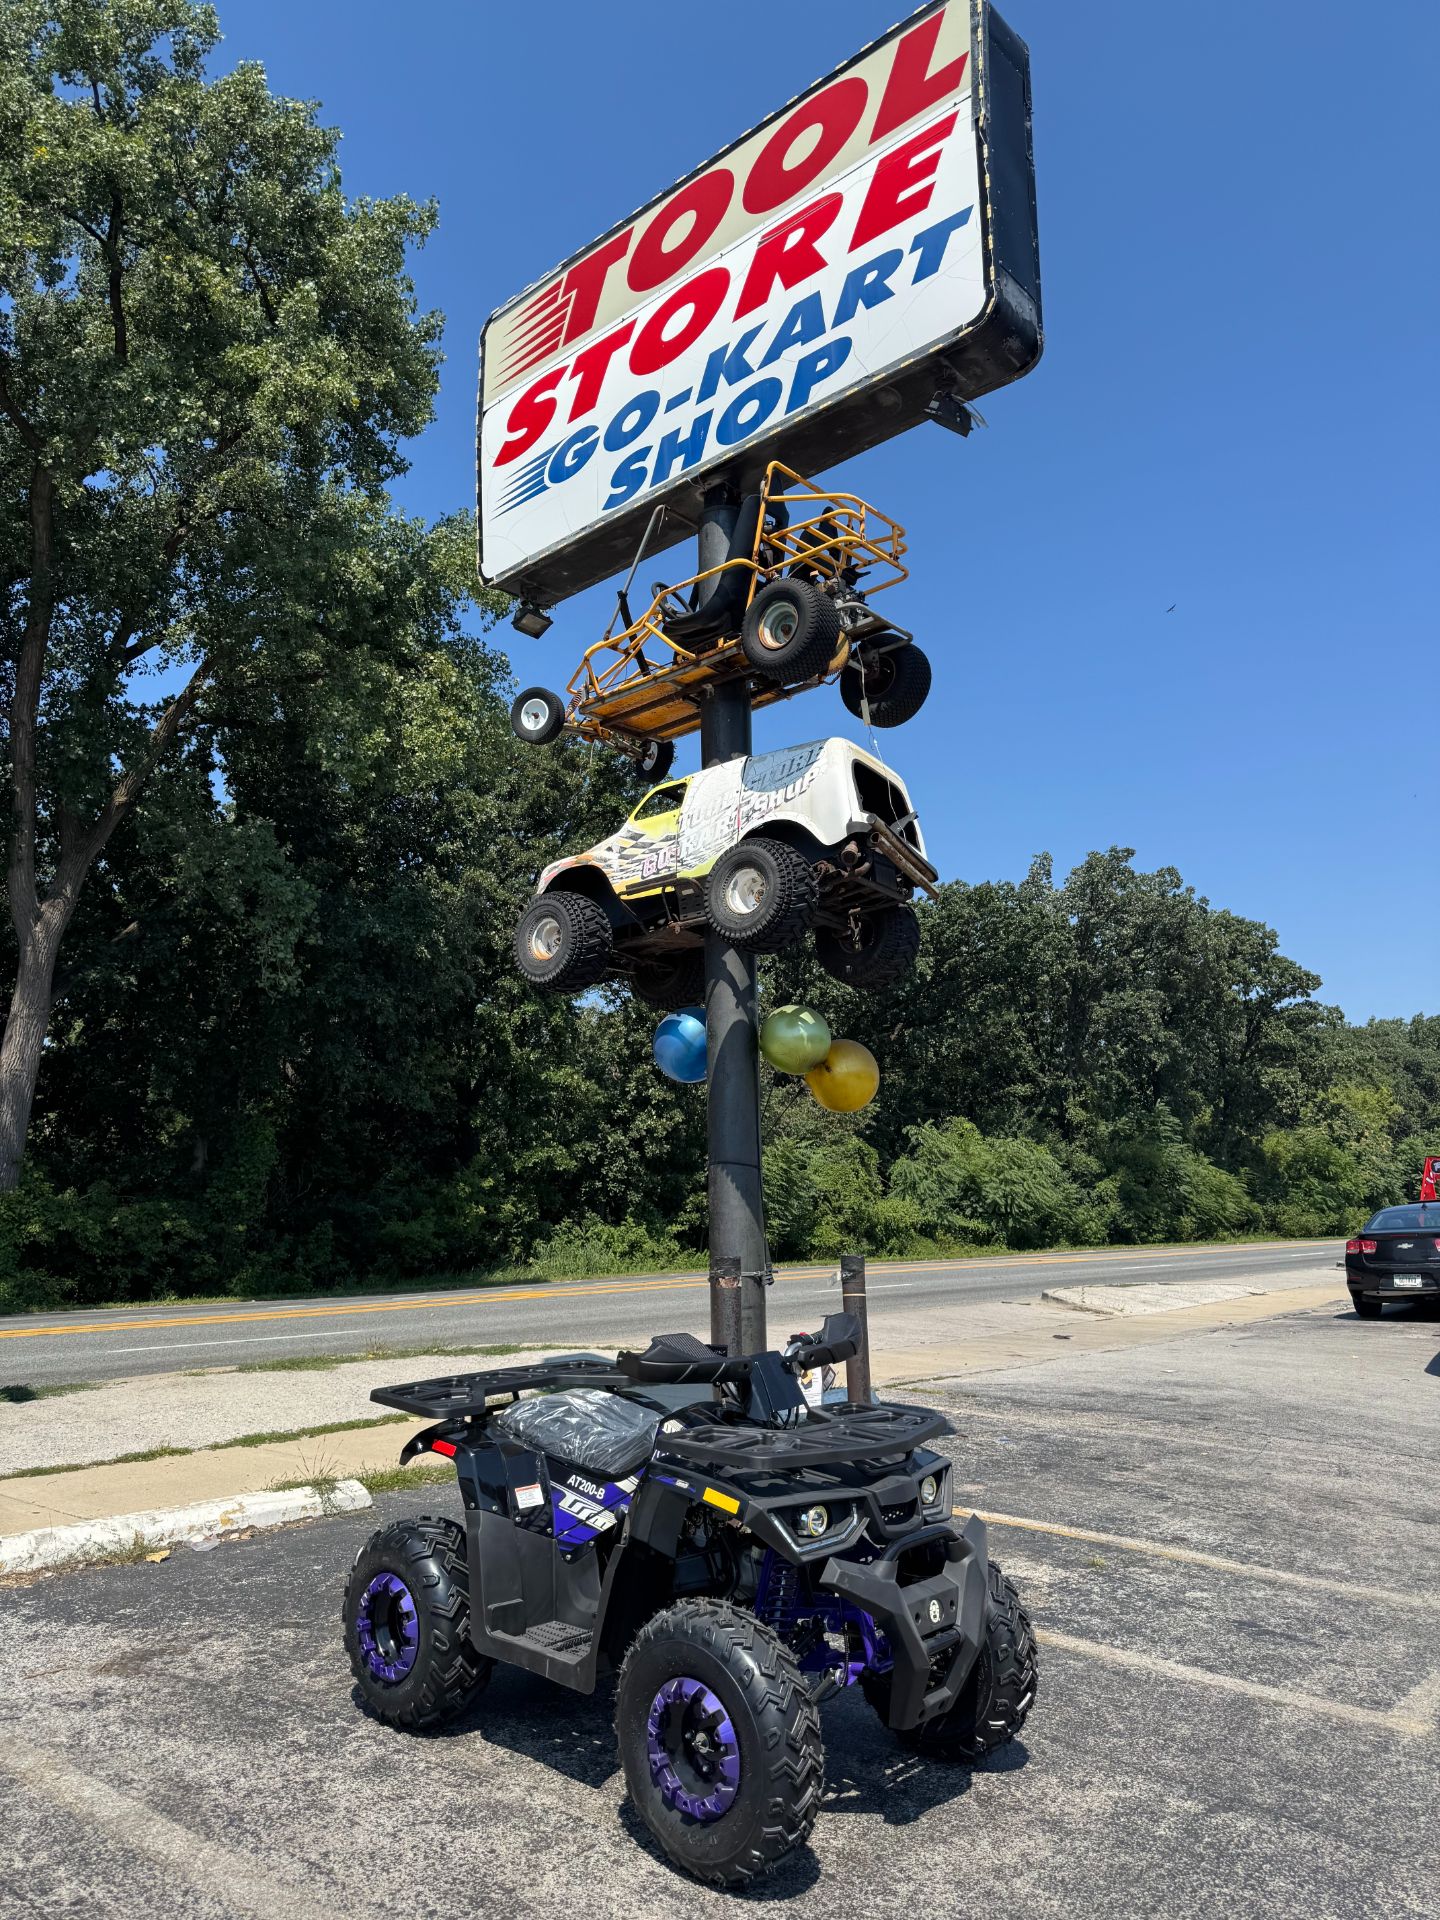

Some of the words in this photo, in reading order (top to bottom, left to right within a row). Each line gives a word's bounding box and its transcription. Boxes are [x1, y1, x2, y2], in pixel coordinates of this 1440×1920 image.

[493, 109, 960, 468] STORE
[561, 8, 970, 348] TOOL
[547, 205, 975, 485] GO-KART
[602, 337, 853, 511] SHOP
[567, 1474, 605, 1500] AT200-B
